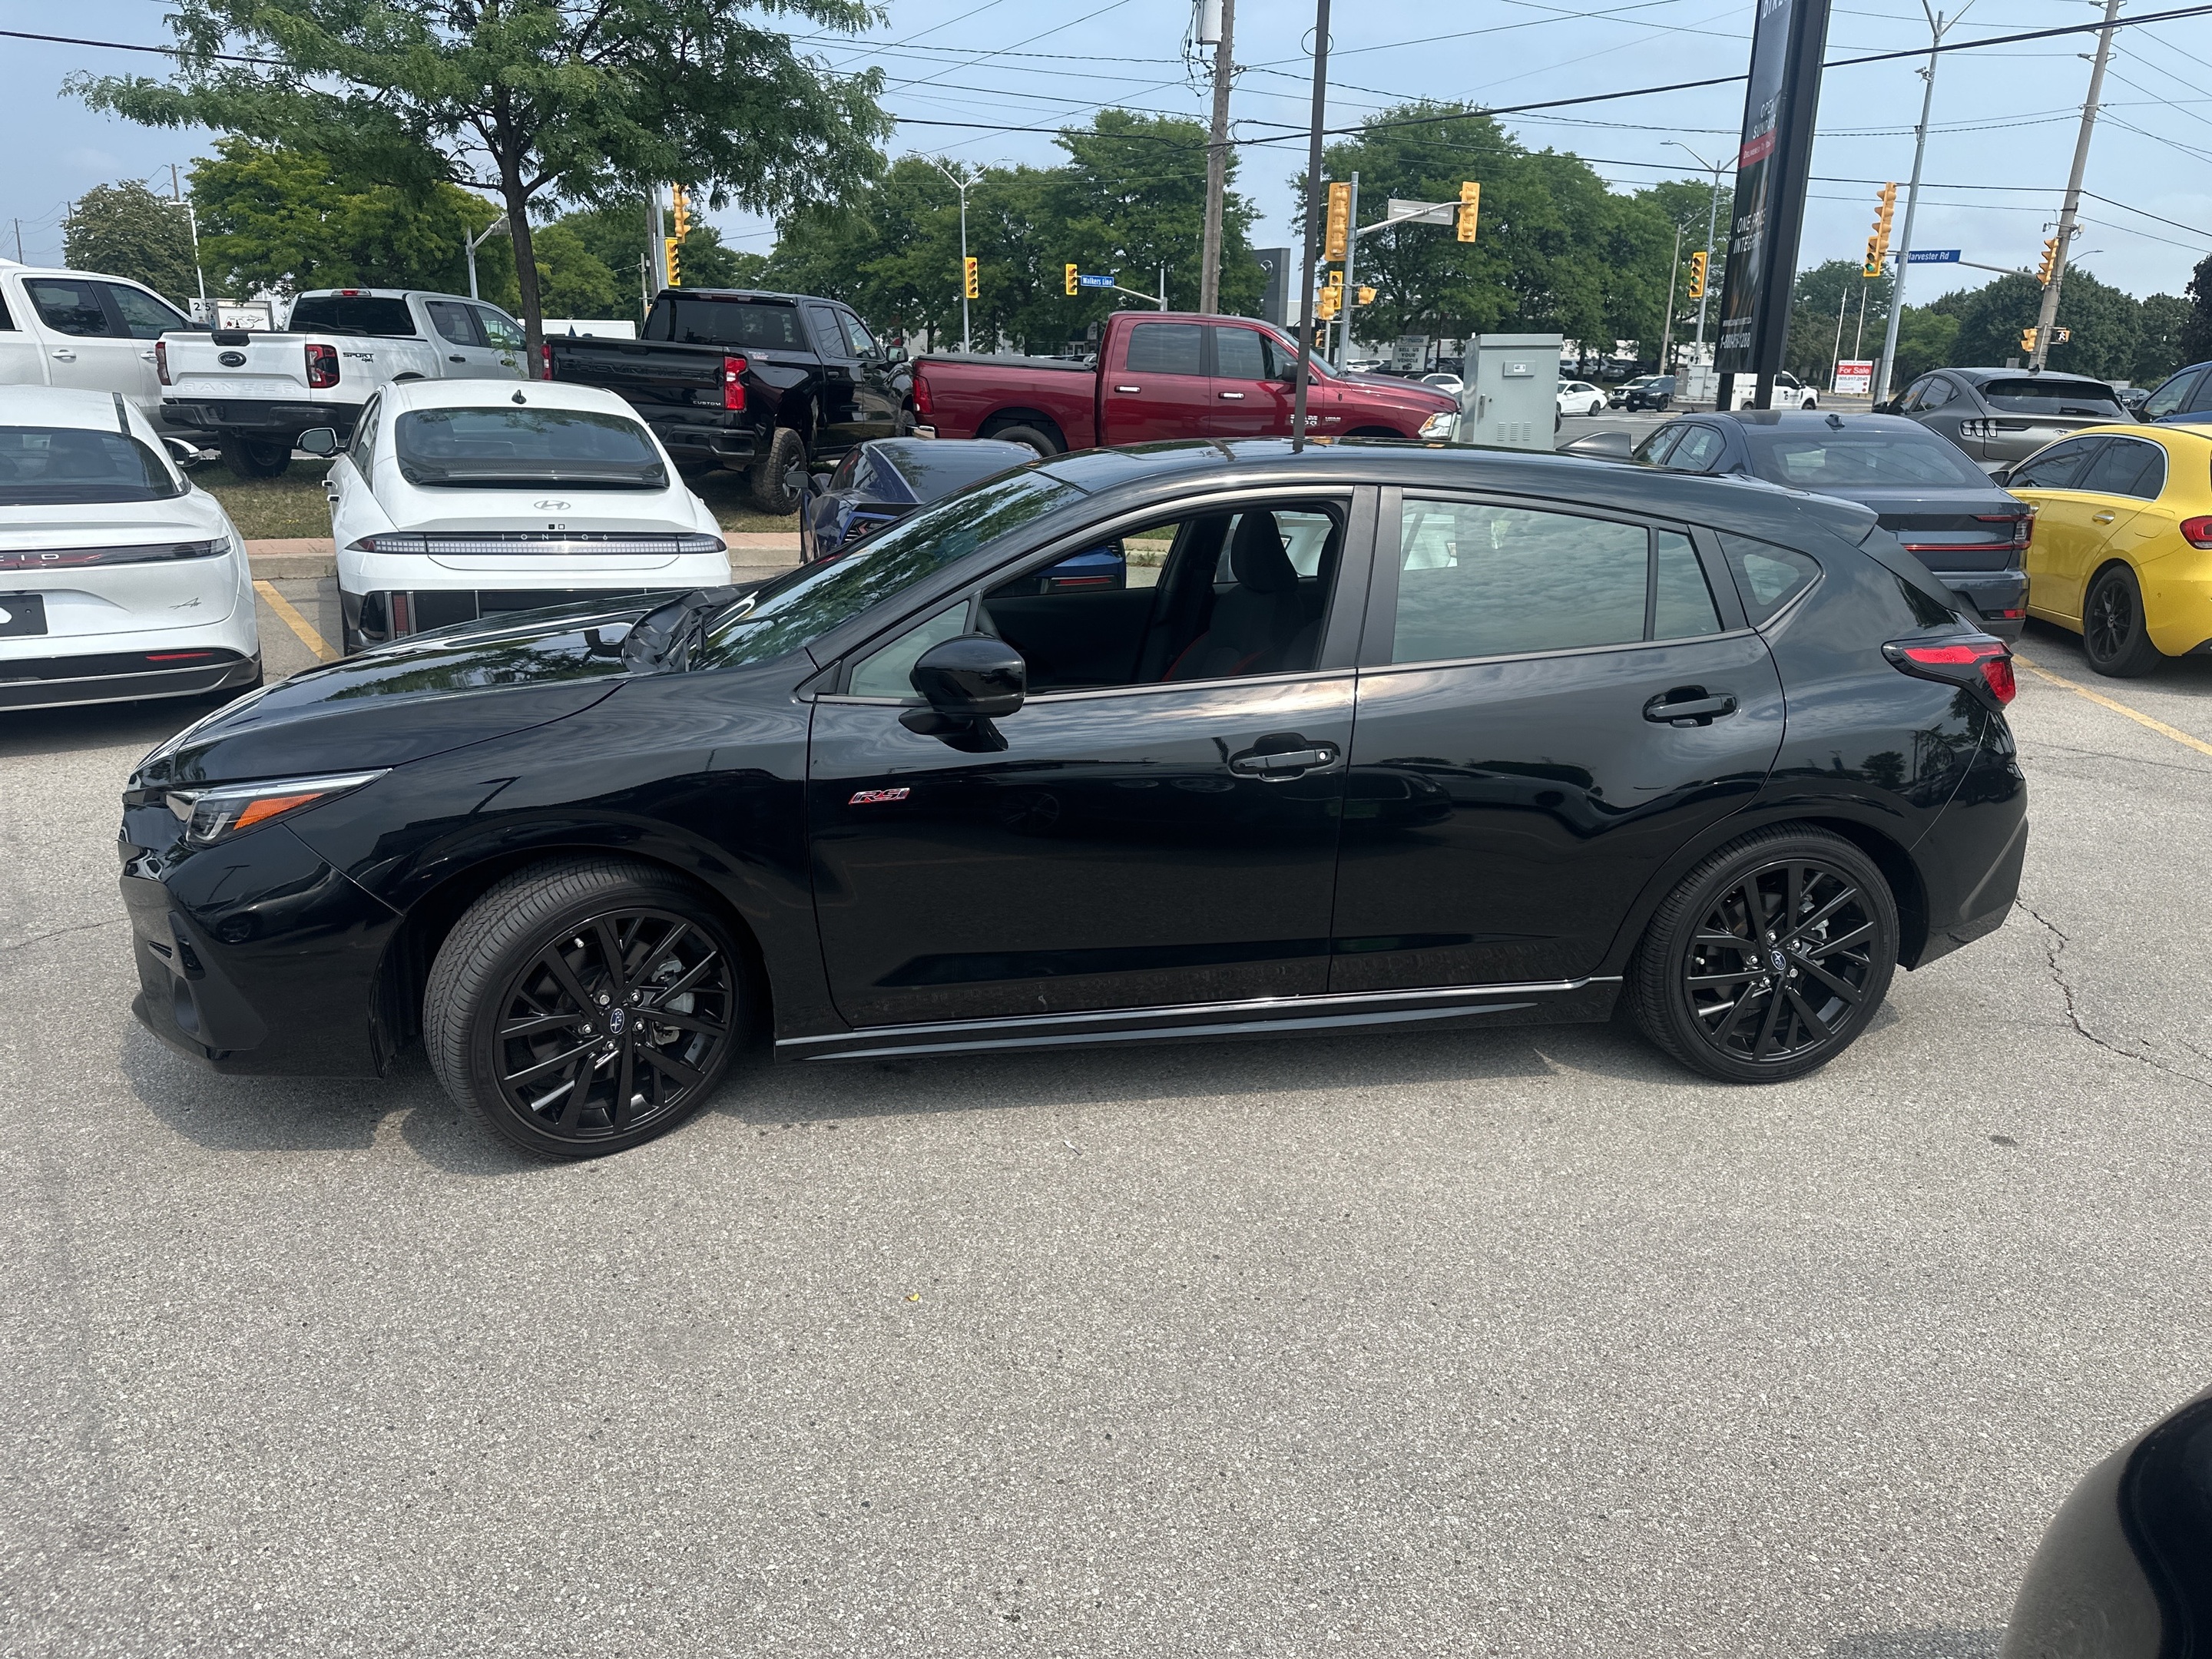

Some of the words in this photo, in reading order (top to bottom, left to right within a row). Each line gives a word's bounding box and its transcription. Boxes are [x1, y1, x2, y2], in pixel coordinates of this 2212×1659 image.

[1737, 214, 1752, 233] ONE
[1939, 251, 1950, 260] Rd
[1083, 276, 1101, 285] Walkers
[181, 382, 296, 395] RANGER
